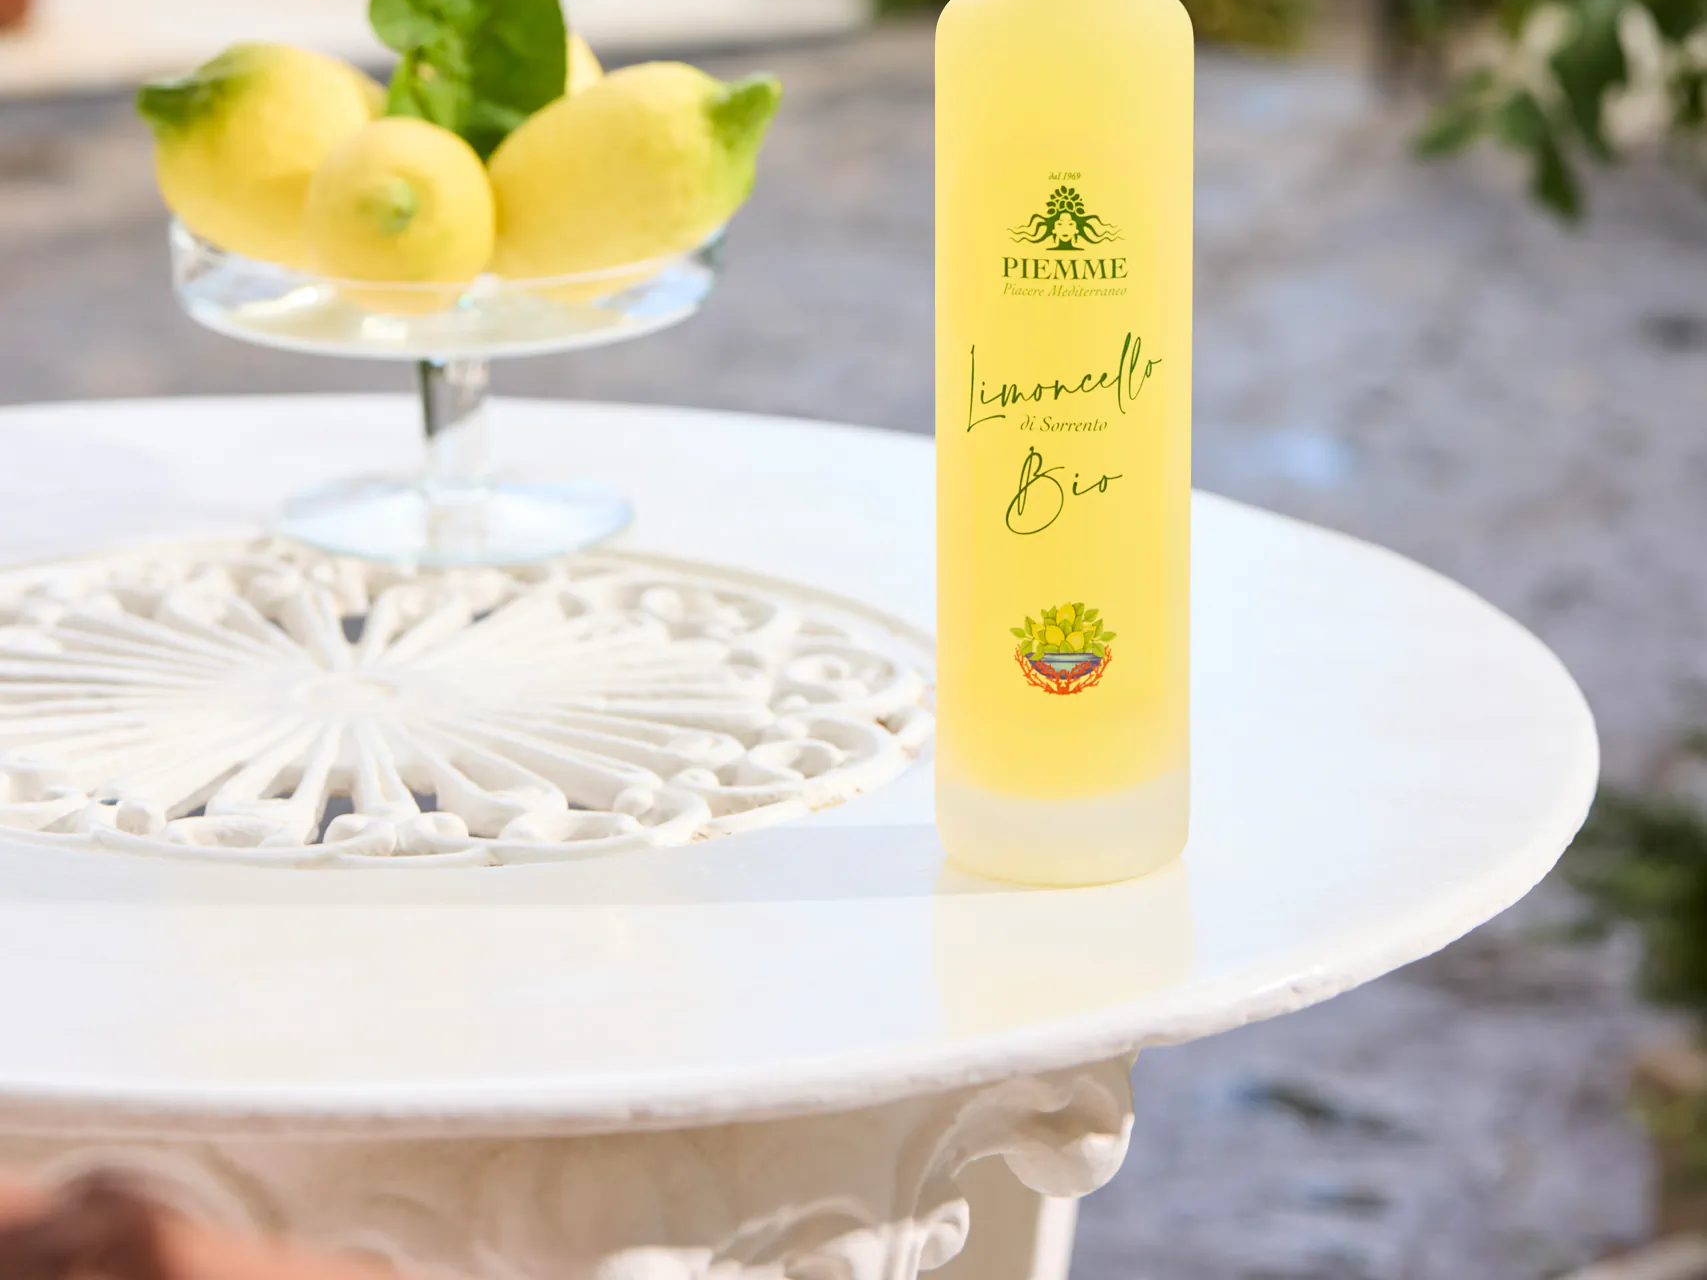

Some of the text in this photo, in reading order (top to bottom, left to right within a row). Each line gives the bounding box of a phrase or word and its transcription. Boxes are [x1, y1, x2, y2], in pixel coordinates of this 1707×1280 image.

[1048, 172, 1082, 181] dal 1969
[1002, 256, 1128, 280] PIEMME
[1003, 282, 1128, 297] Piacere Mediterraneo
[967, 332, 1162, 433] Limoncello
[1020, 414, 1108, 432] di Sorrento
[1005, 446, 1123, 535] Bio
